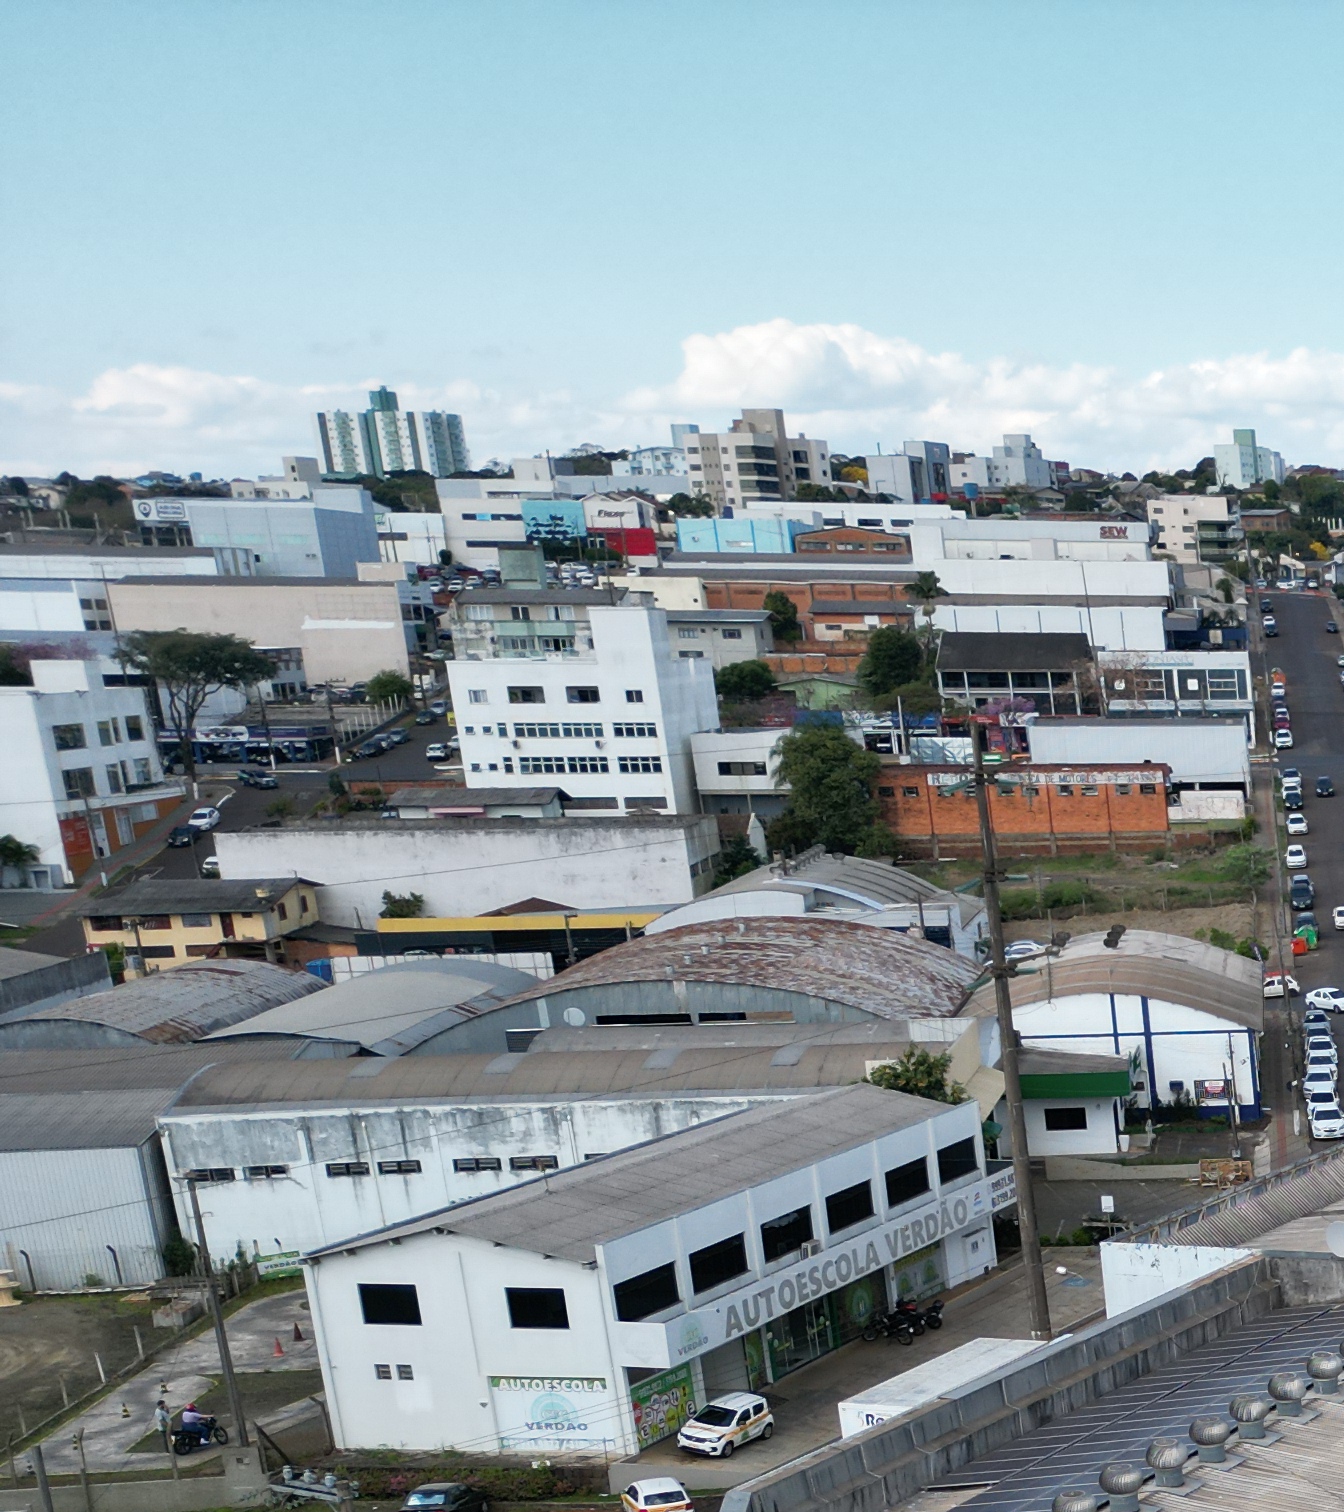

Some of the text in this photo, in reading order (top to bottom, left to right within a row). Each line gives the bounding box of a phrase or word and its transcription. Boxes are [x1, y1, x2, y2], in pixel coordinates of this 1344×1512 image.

[725, 1198, 968, 1339] AUTOESCOLA VERDÃO
[498, 1379, 606, 1393] AUTOESCOLA
